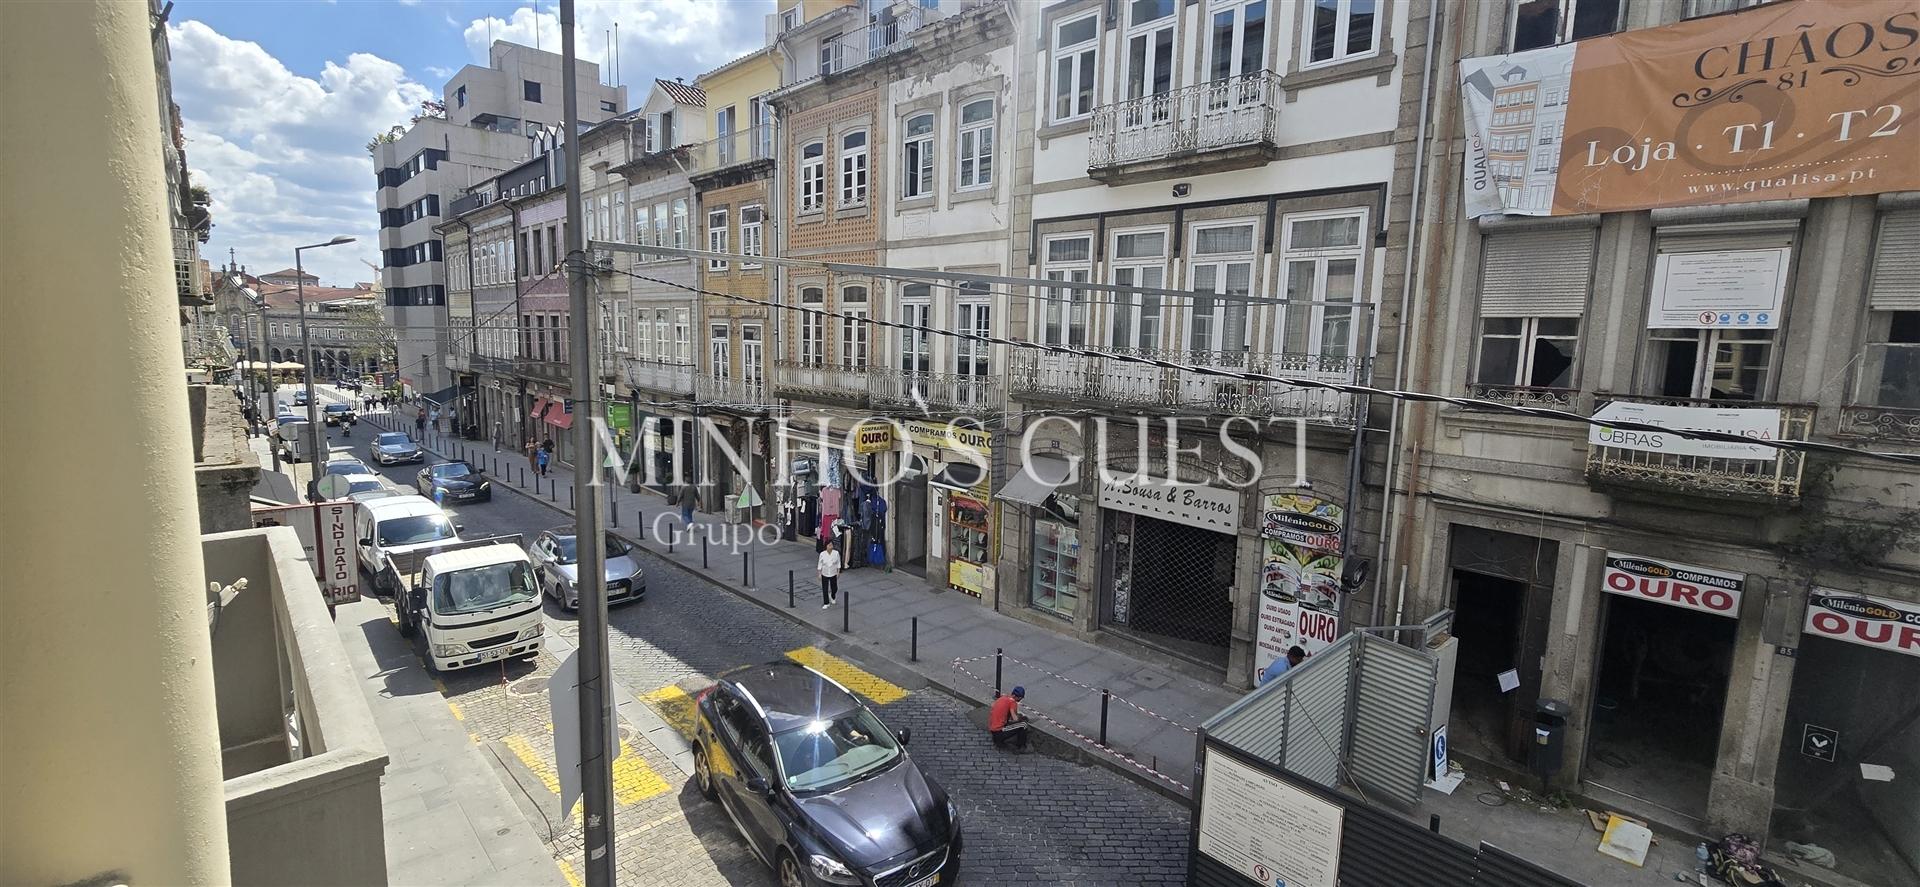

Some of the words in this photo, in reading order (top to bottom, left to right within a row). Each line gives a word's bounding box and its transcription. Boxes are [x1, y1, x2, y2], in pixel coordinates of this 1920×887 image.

[1694, 12, 1919, 81] CHÃOS
[1776, 70, 1808, 91] 81
[1584, 137, 1677, 171] Loja
[1722, 121, 1776, 154] T1
[1827, 104, 1903, 143] T2
[1687, 167, 1877, 195] www.qualisa.pt
[861, 432, 889, 444] OURO
[909, 425, 957, 439] COMPRAMOS
[1599, 428, 1663, 448] OBRAS
[1166, 487, 1177, 503] &
[1183, 489, 1232, 514] Barros
[331, 506, 347, 580] SINDICATO
[1264, 527, 1305, 541] COMPRAMOS
[1607, 572, 1734, 611] OURO
[1676, 571, 1737, 588] COMPRAMOS
[1299, 610, 1336, 643] OURO
[1780, 647, 1792, 656] 85
